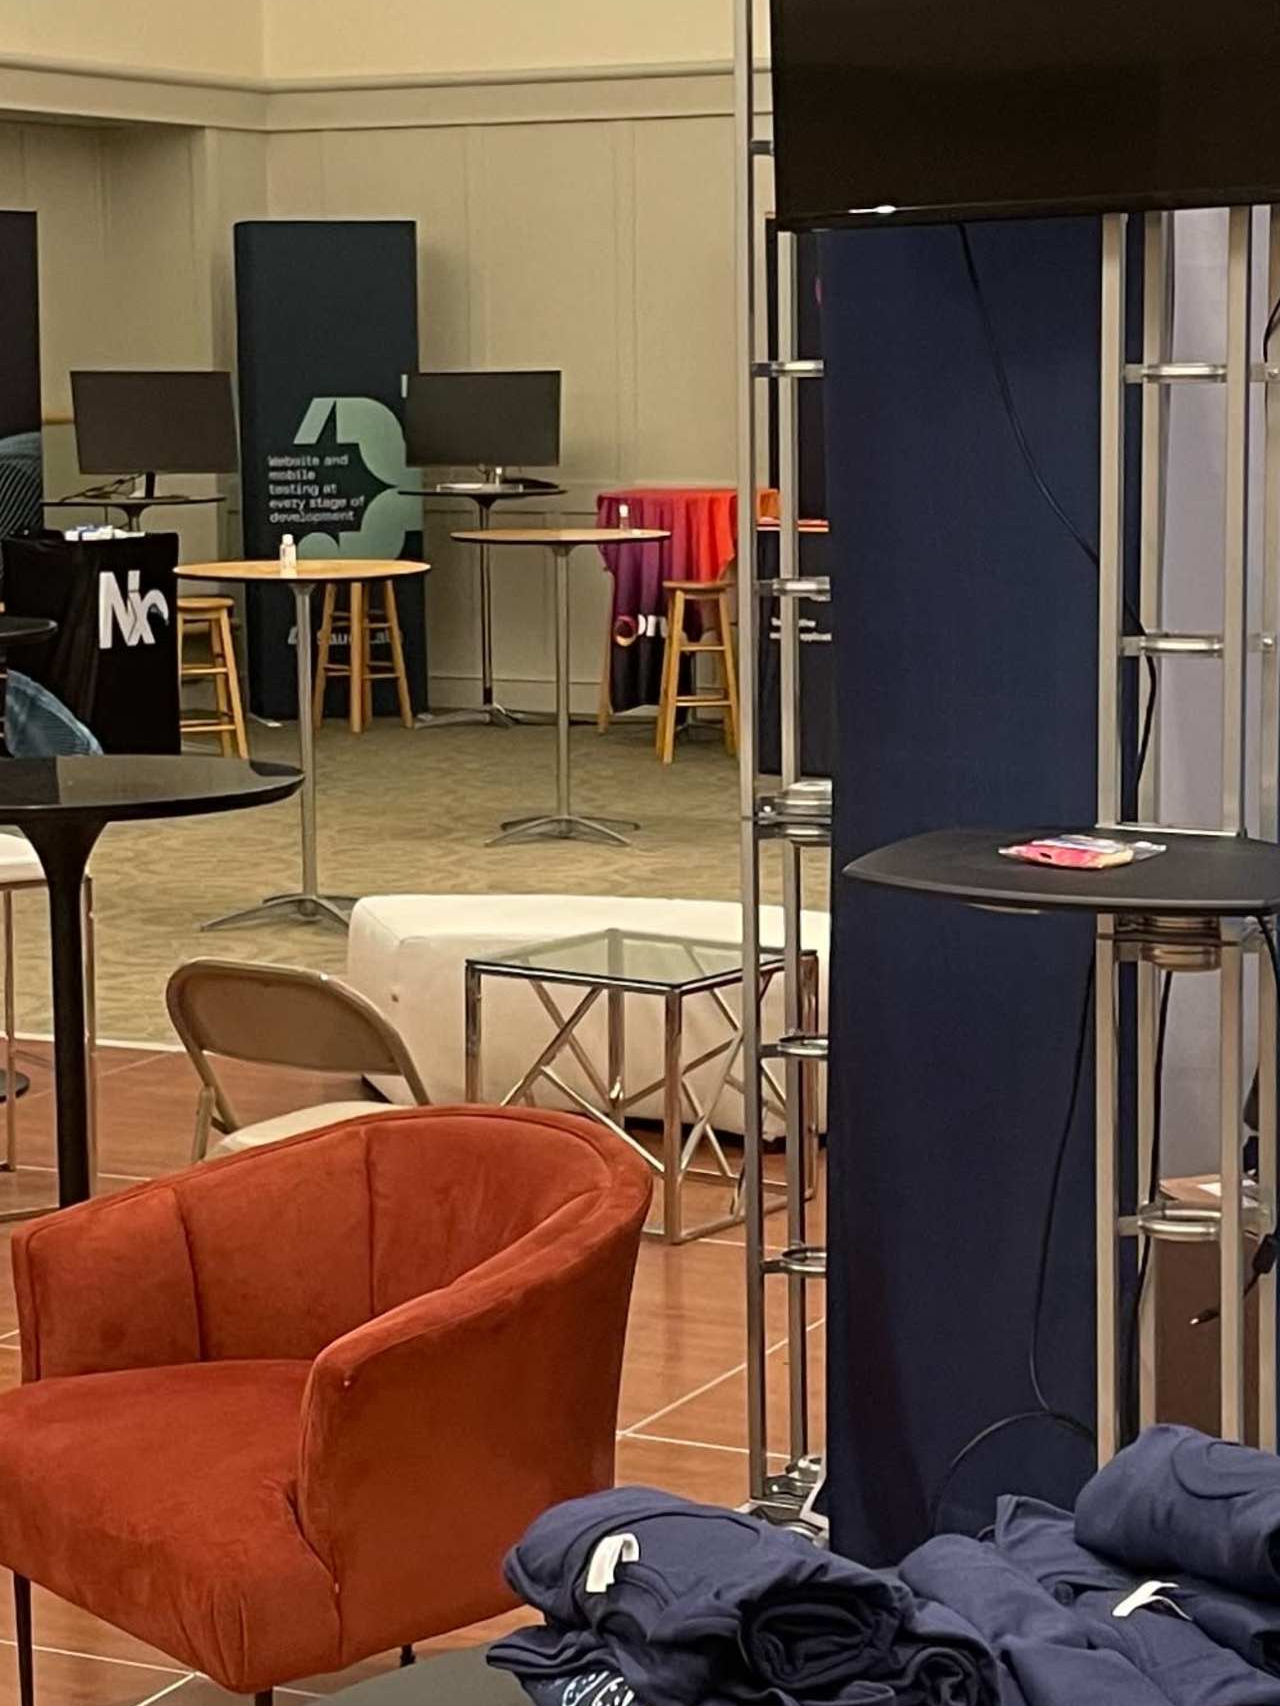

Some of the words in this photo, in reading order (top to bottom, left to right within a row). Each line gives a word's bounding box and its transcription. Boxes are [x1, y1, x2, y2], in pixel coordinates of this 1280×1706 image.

[323, 454, 350, 467] and
[268, 469, 316, 481] mobile
[268, 484, 320, 497] testing
[323, 483, 337, 494] at
[269, 498, 306, 512] every
[309, 497, 347, 510] stage
[350, 495, 365, 507] of
[269, 510, 355, 523] development
[99, 569, 169, 650] Nx
